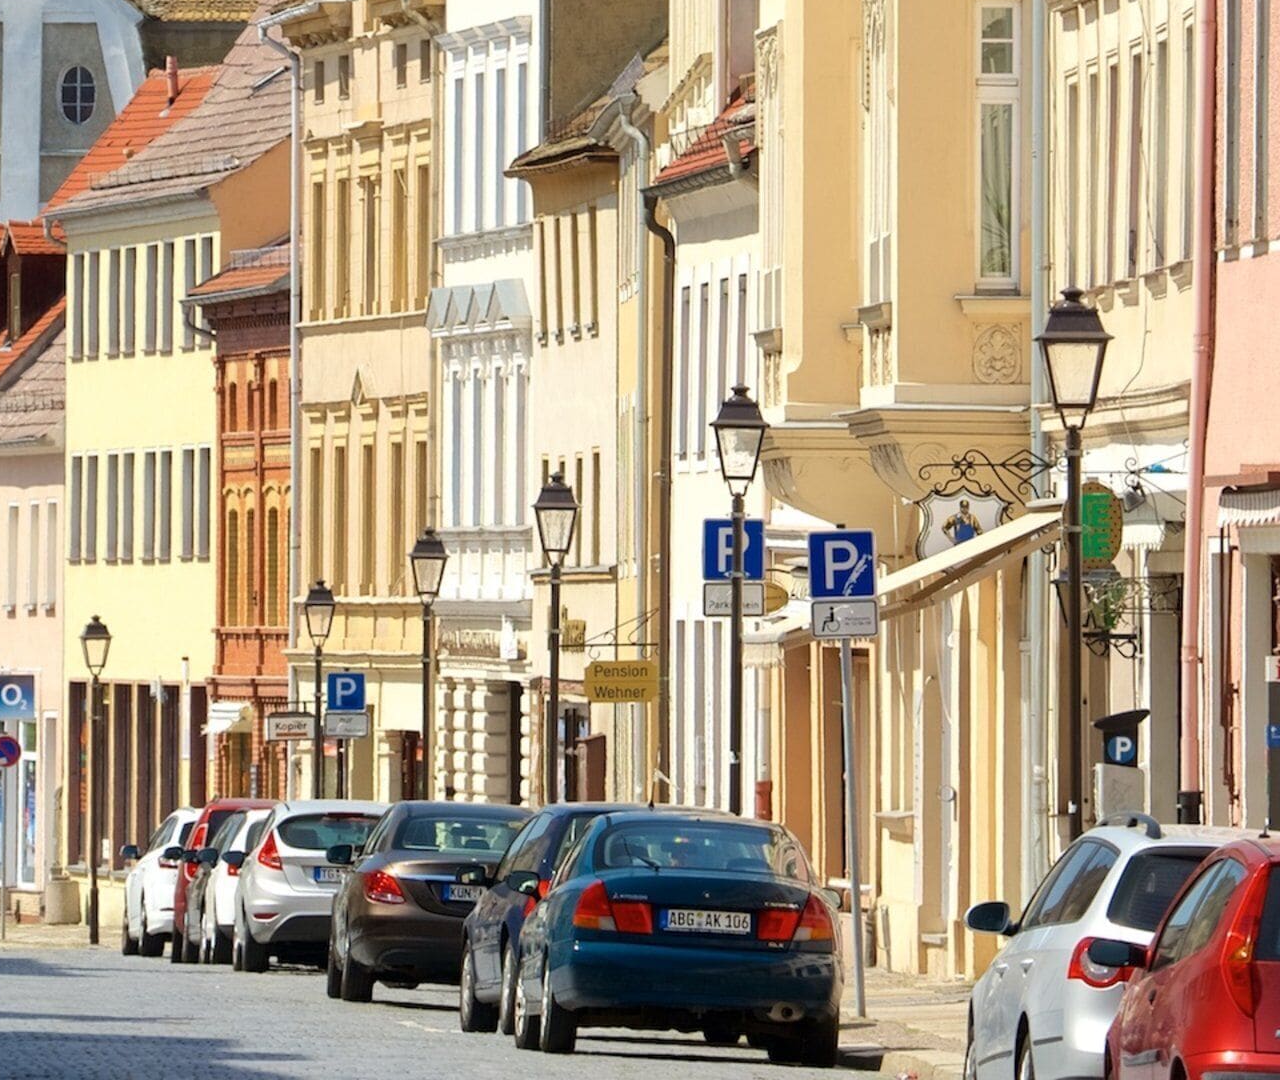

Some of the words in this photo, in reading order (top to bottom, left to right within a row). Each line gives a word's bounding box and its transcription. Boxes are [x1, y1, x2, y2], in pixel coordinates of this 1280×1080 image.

[718, 527, 750, 572] P
[824, 540, 859, 590] P
[594, 664, 648, 677] Pension
[336, 678, 357, 707] P
[594, 686, 647, 698] Wehner
[1115, 736, 1132, 761] P
[669, 911, 694, 926] ABG
[705, 913, 721, 927] AK
[725, 914, 749, 929] 106
